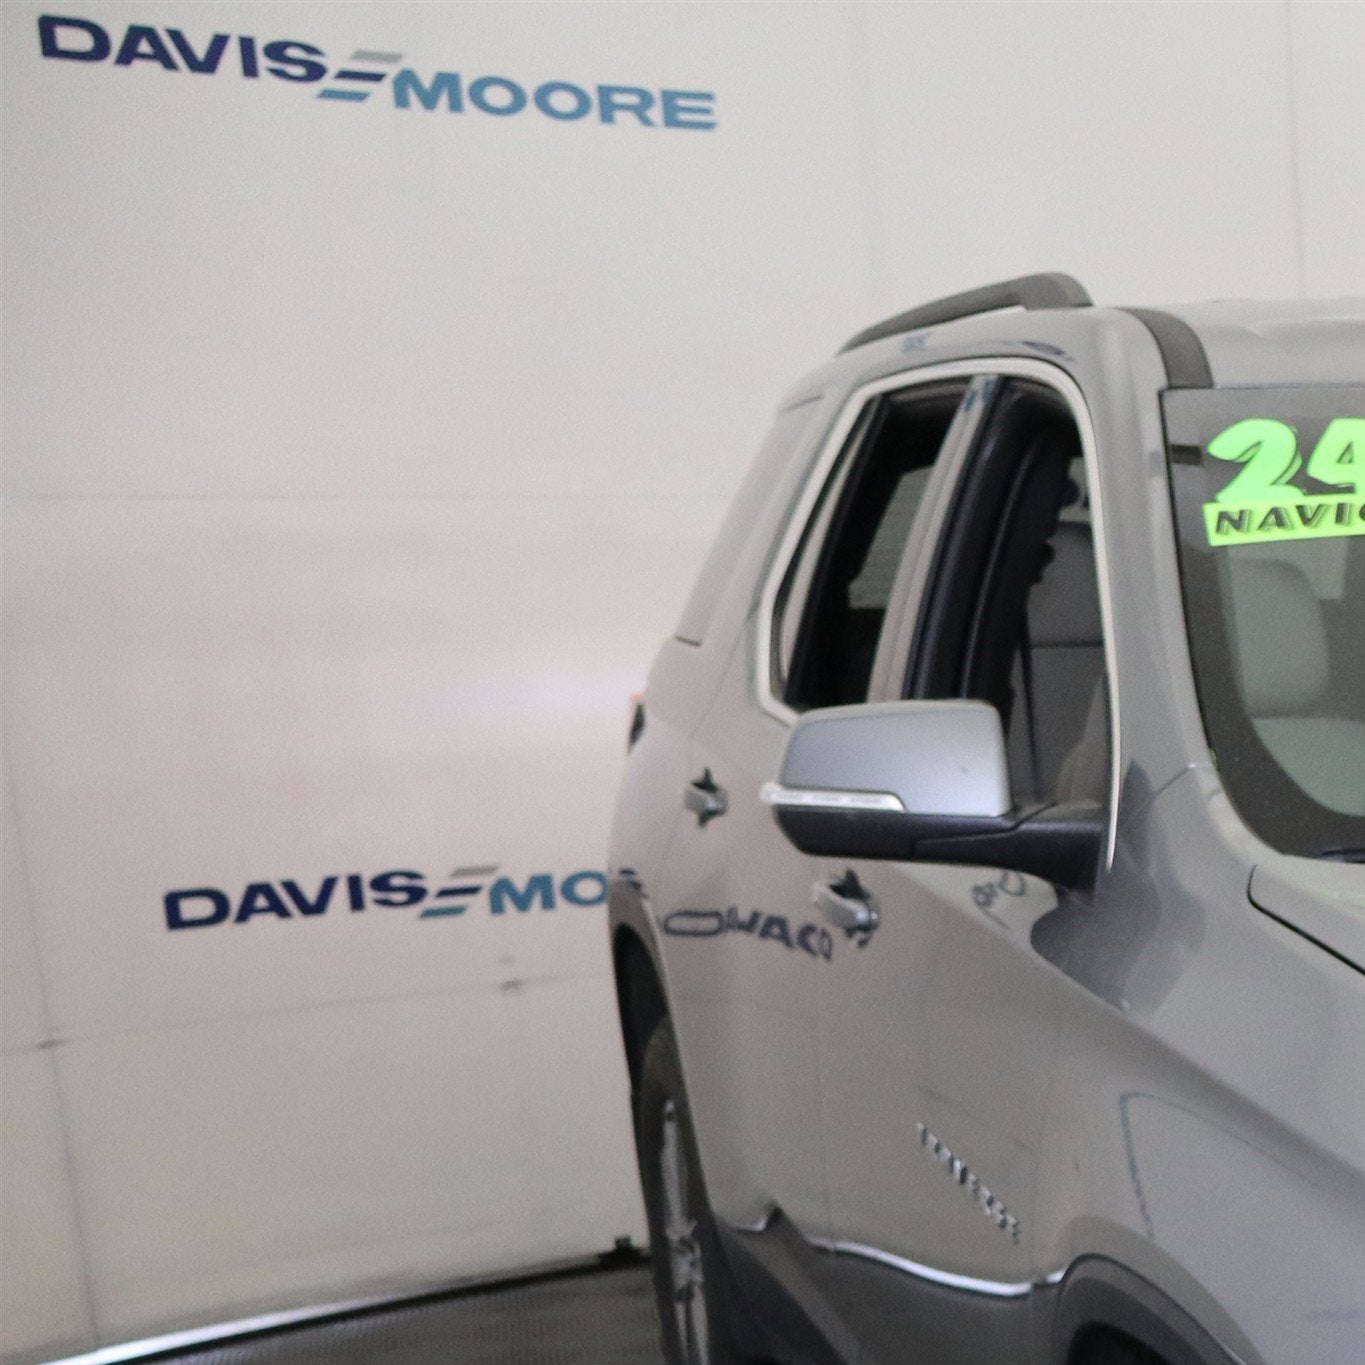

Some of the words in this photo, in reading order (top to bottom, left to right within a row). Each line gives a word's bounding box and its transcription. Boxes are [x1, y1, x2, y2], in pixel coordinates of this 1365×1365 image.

[38, 14, 327, 84] DAVIS
[392, 67, 718, 132] MOORE
[163, 870, 430, 931] DAVIS
